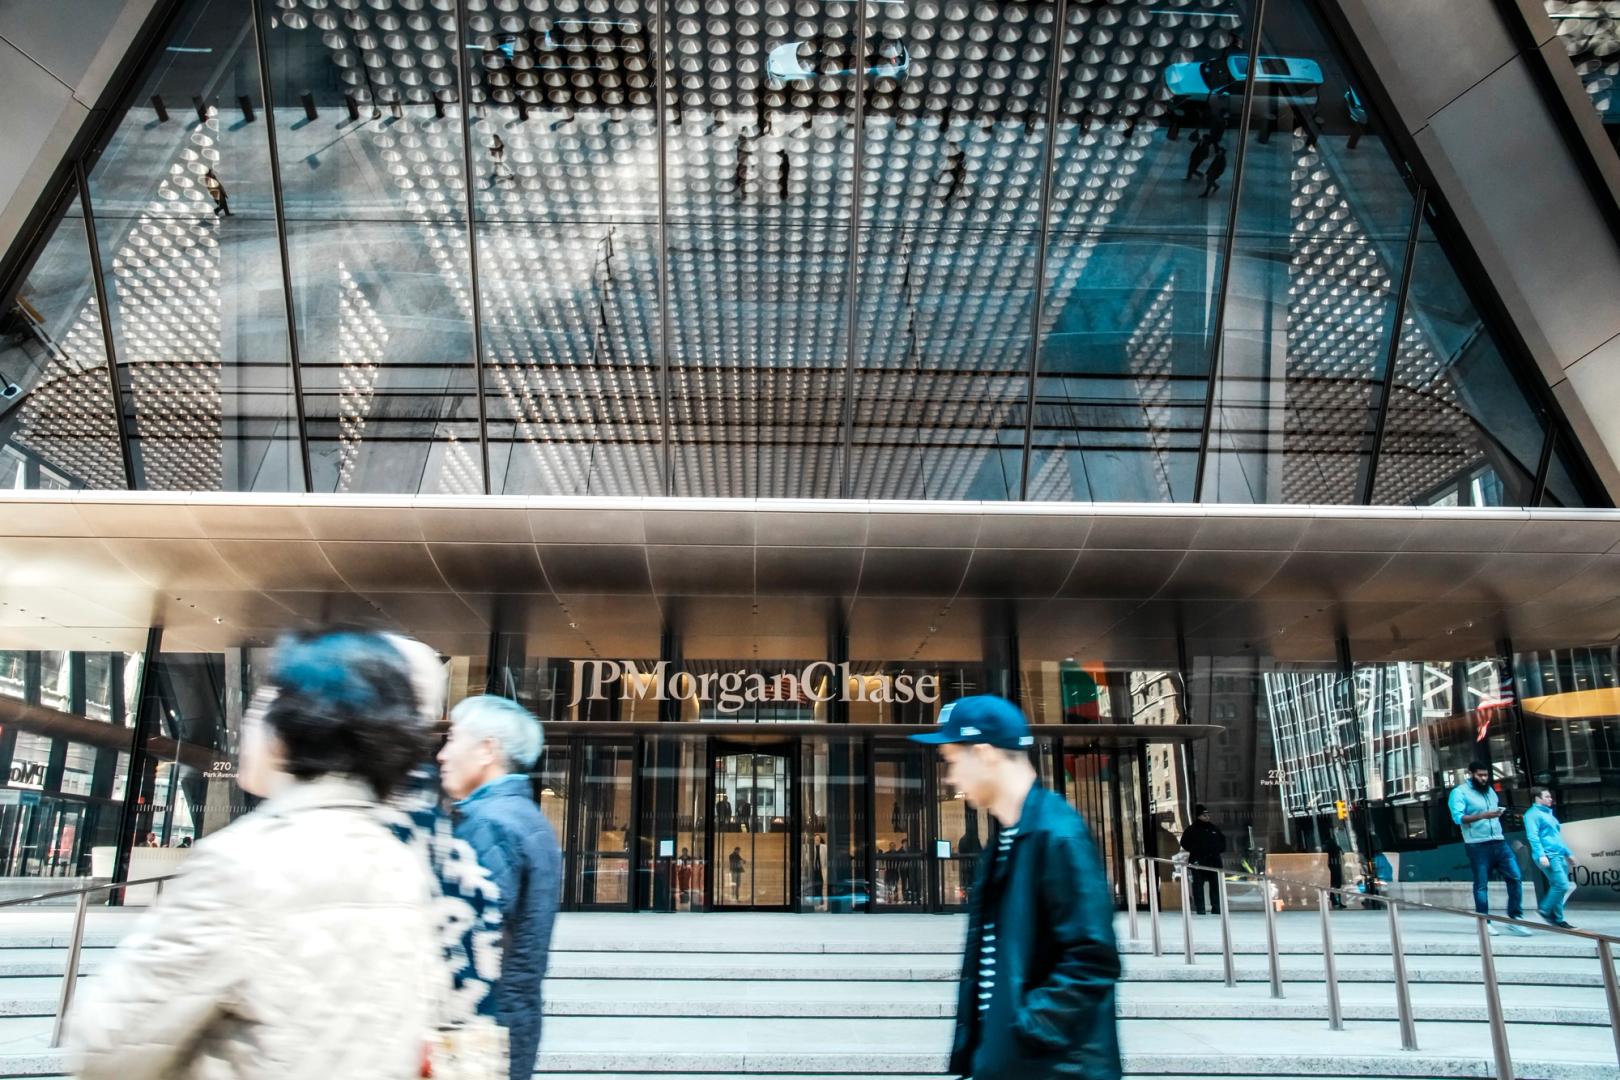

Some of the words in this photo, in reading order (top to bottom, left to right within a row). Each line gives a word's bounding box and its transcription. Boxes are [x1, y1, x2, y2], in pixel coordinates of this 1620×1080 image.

[566, 660, 941, 713] JPMorganChase
[212, 761, 232, 771] 270
[1268, 769, 1286, 778] 270
